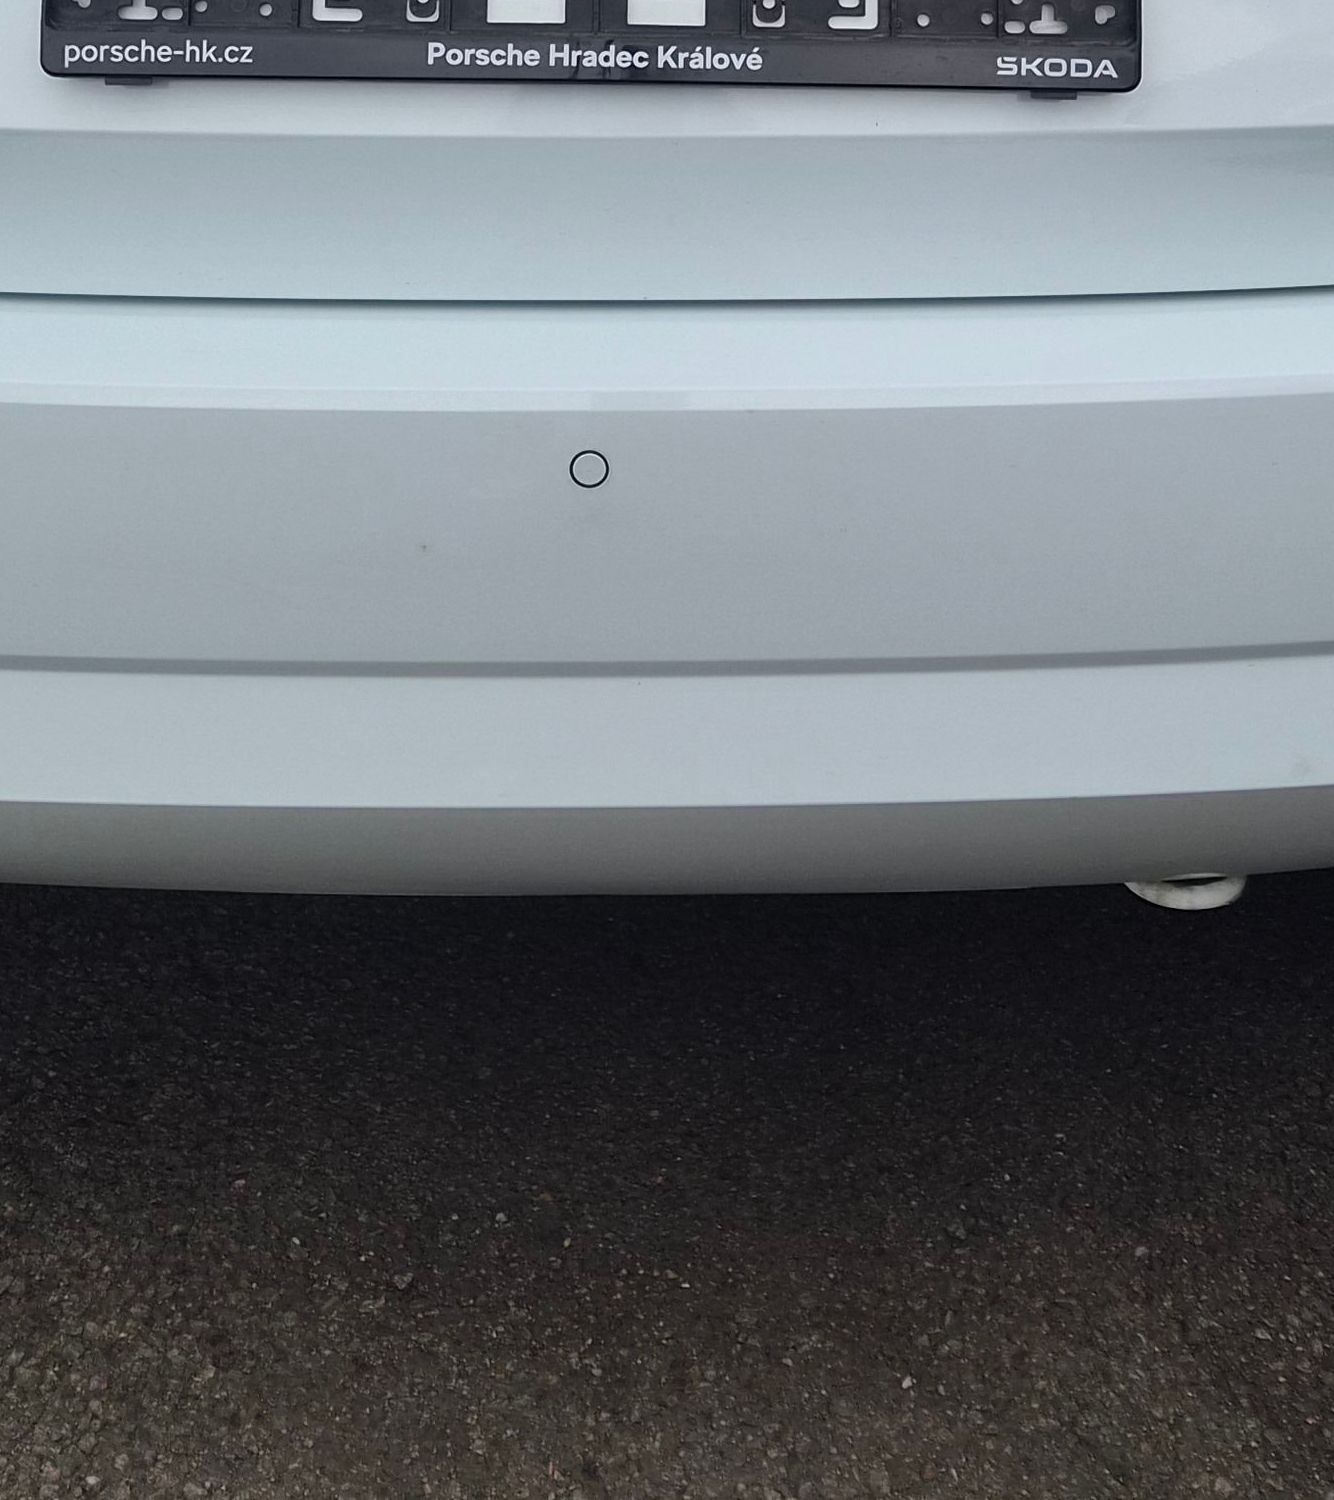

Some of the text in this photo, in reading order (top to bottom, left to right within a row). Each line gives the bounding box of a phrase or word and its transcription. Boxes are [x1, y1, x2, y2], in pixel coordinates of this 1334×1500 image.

[63, 39, 254, 69] porsche-hk.cz
[427, 41, 764, 71] Porsche Hradec Králové
